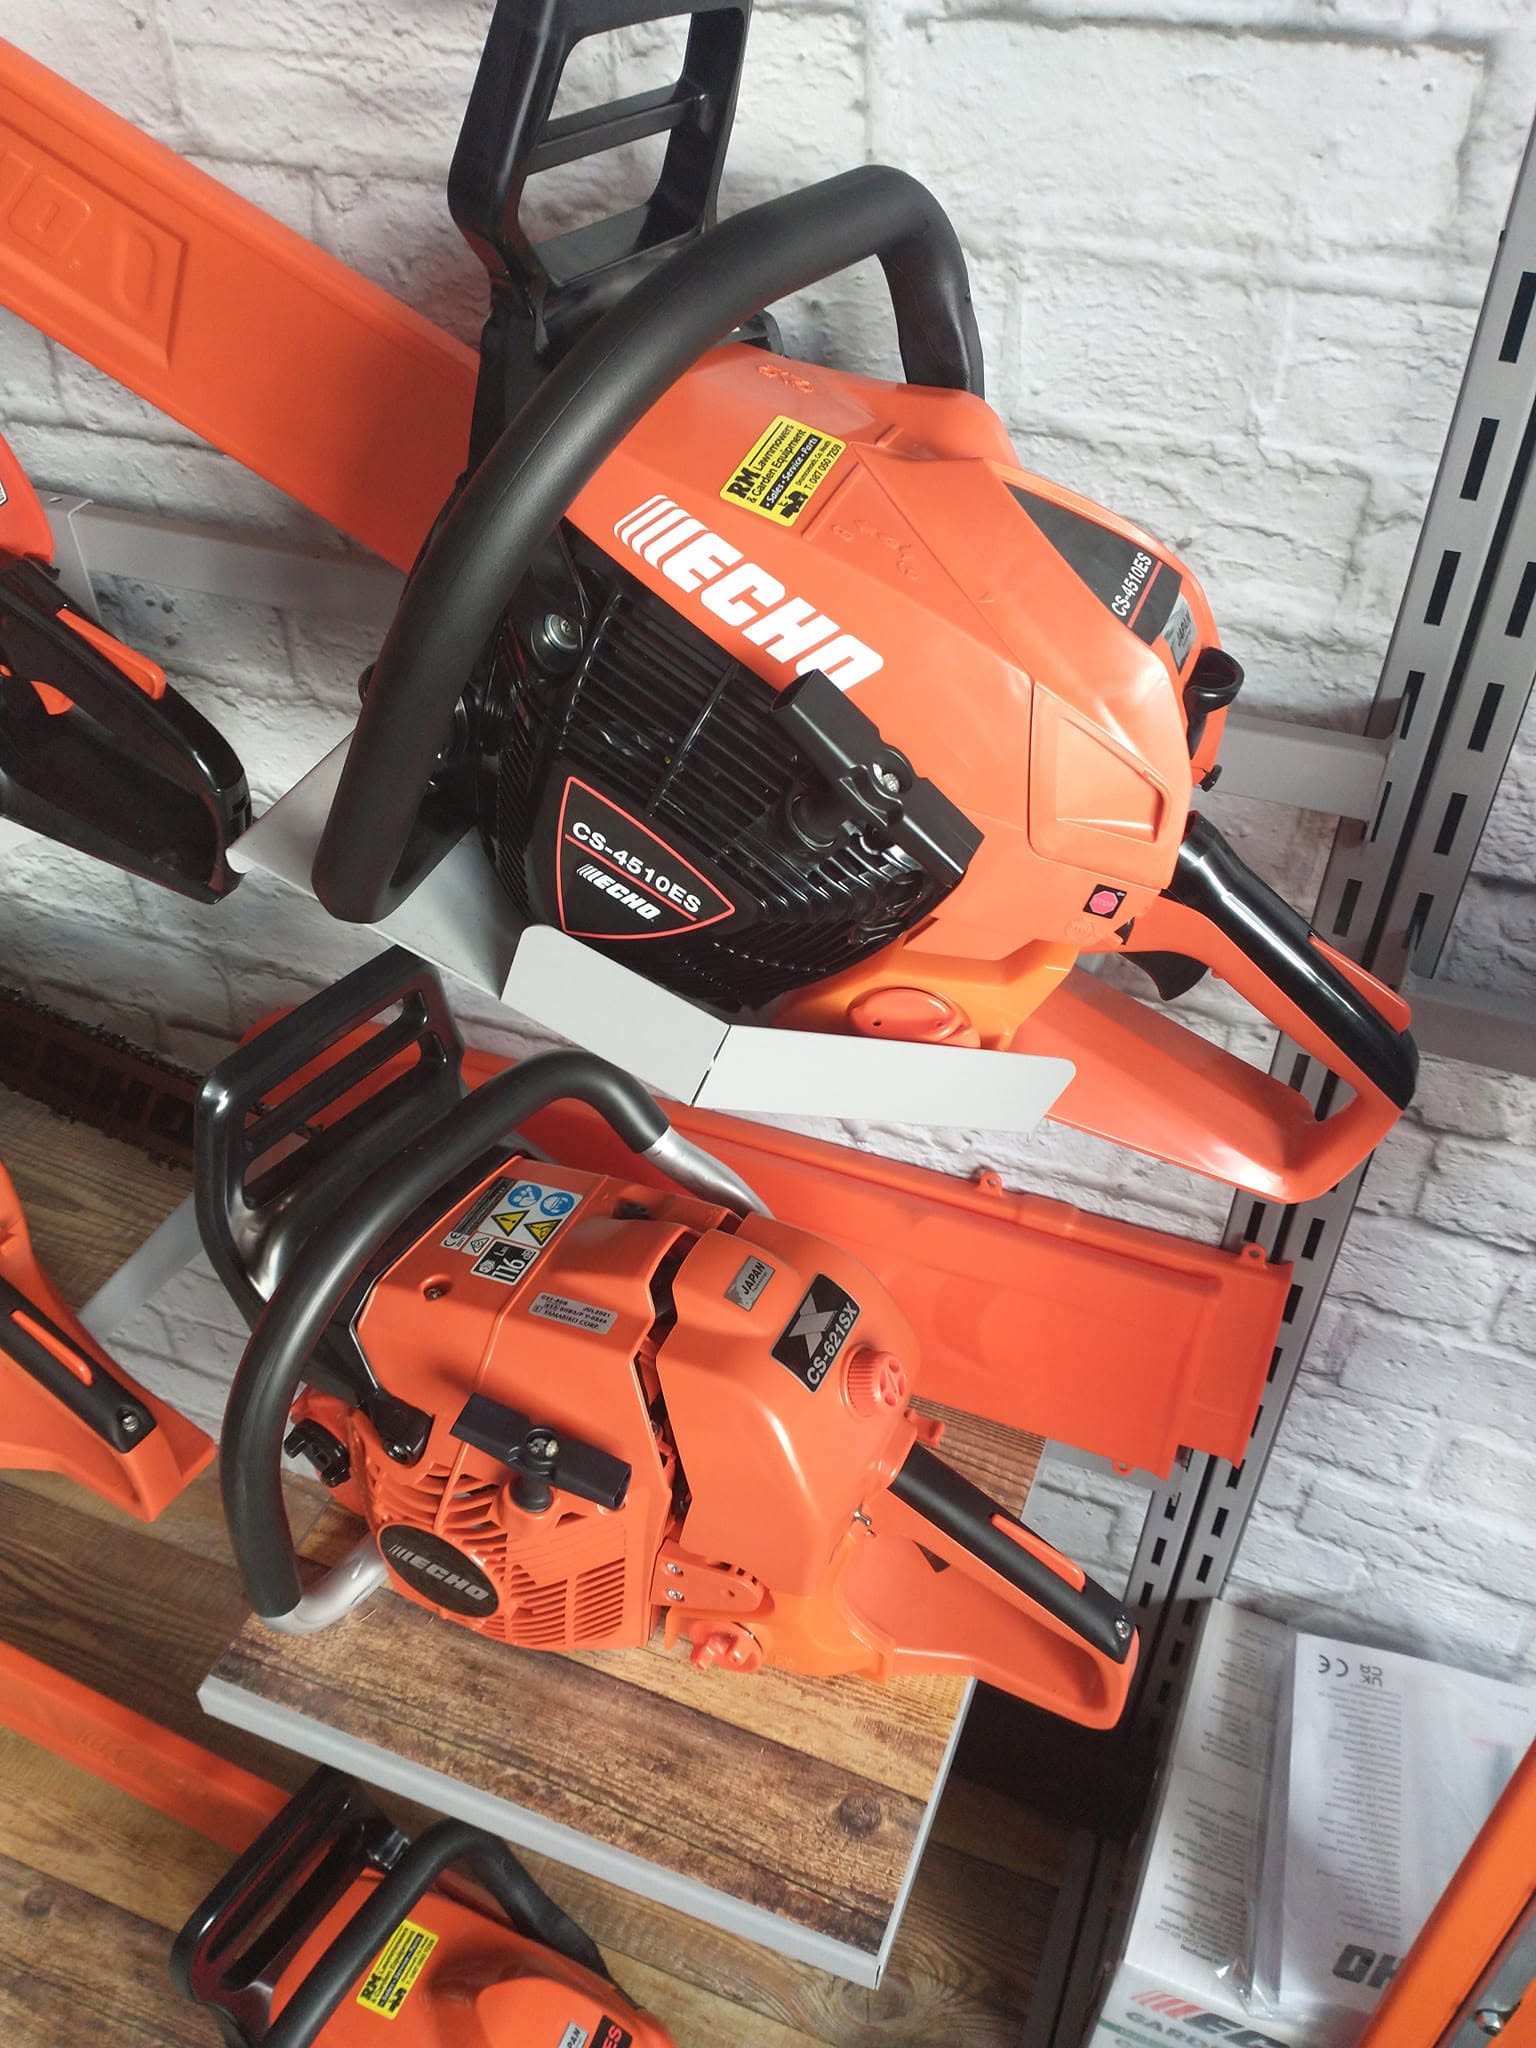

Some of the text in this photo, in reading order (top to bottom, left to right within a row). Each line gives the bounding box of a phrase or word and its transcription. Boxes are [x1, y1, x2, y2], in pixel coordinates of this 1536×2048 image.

[747, 429, 807, 504] & Garden Equipment
[753, 424, 794, 471] Lawnmowers
[766, 437, 819, 504] Sales Service Parts
[727, 467, 761, 499] RM
[661, 531, 885, 693] ECHO
[1111, 551, 1152, 617] CS-4510ES
[572, 821, 702, 914] CS-4510ES
[592, 873, 662, 920] ECHO
[491, 1258, 526, 1281] 116
[741, 1261, 766, 1295] JAPAN
[806, 1301, 858, 1385] CS-621SX
[408, 1554, 490, 1601] ECHO
